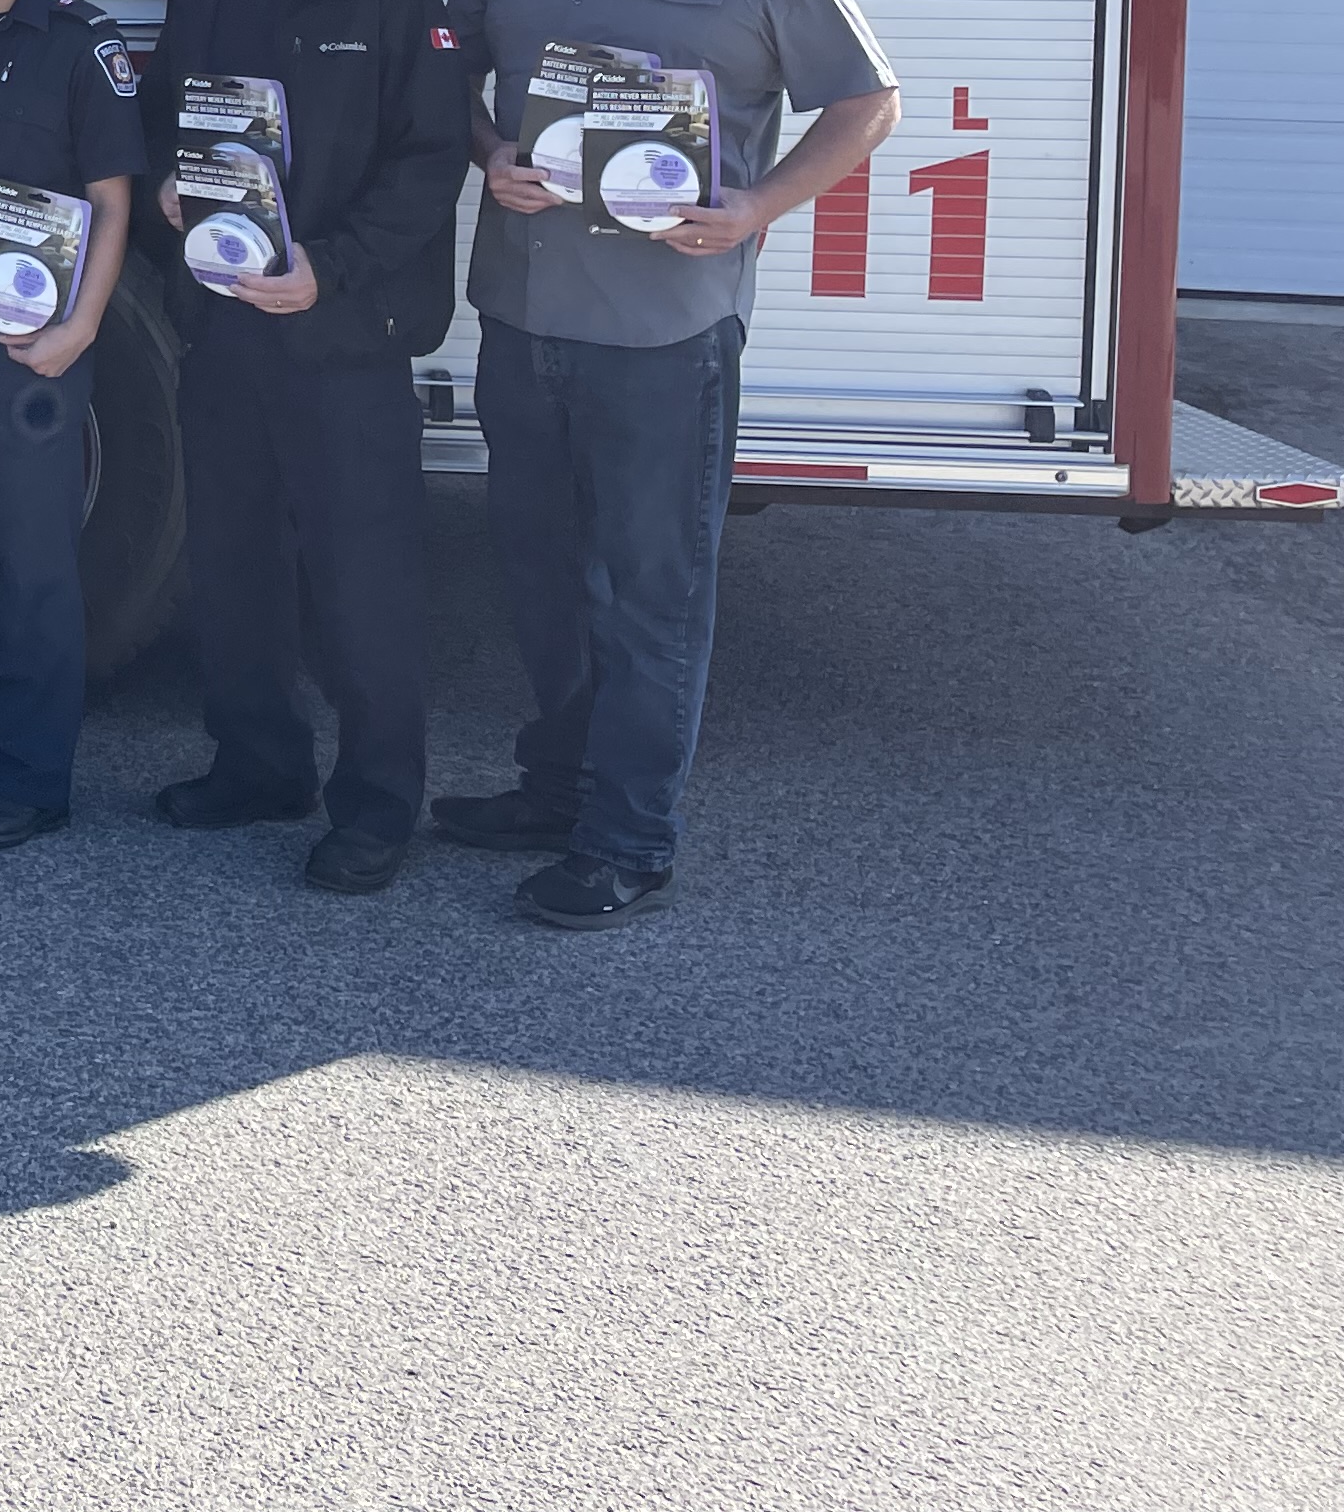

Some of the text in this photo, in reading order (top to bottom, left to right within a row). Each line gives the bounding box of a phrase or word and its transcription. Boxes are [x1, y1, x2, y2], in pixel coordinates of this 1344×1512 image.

[328, 41, 367, 51] Columbia
[554, 44, 578, 55] Kidde
[602, 75, 625, 83] Kidde
[756, 149, 990, 302] 11
